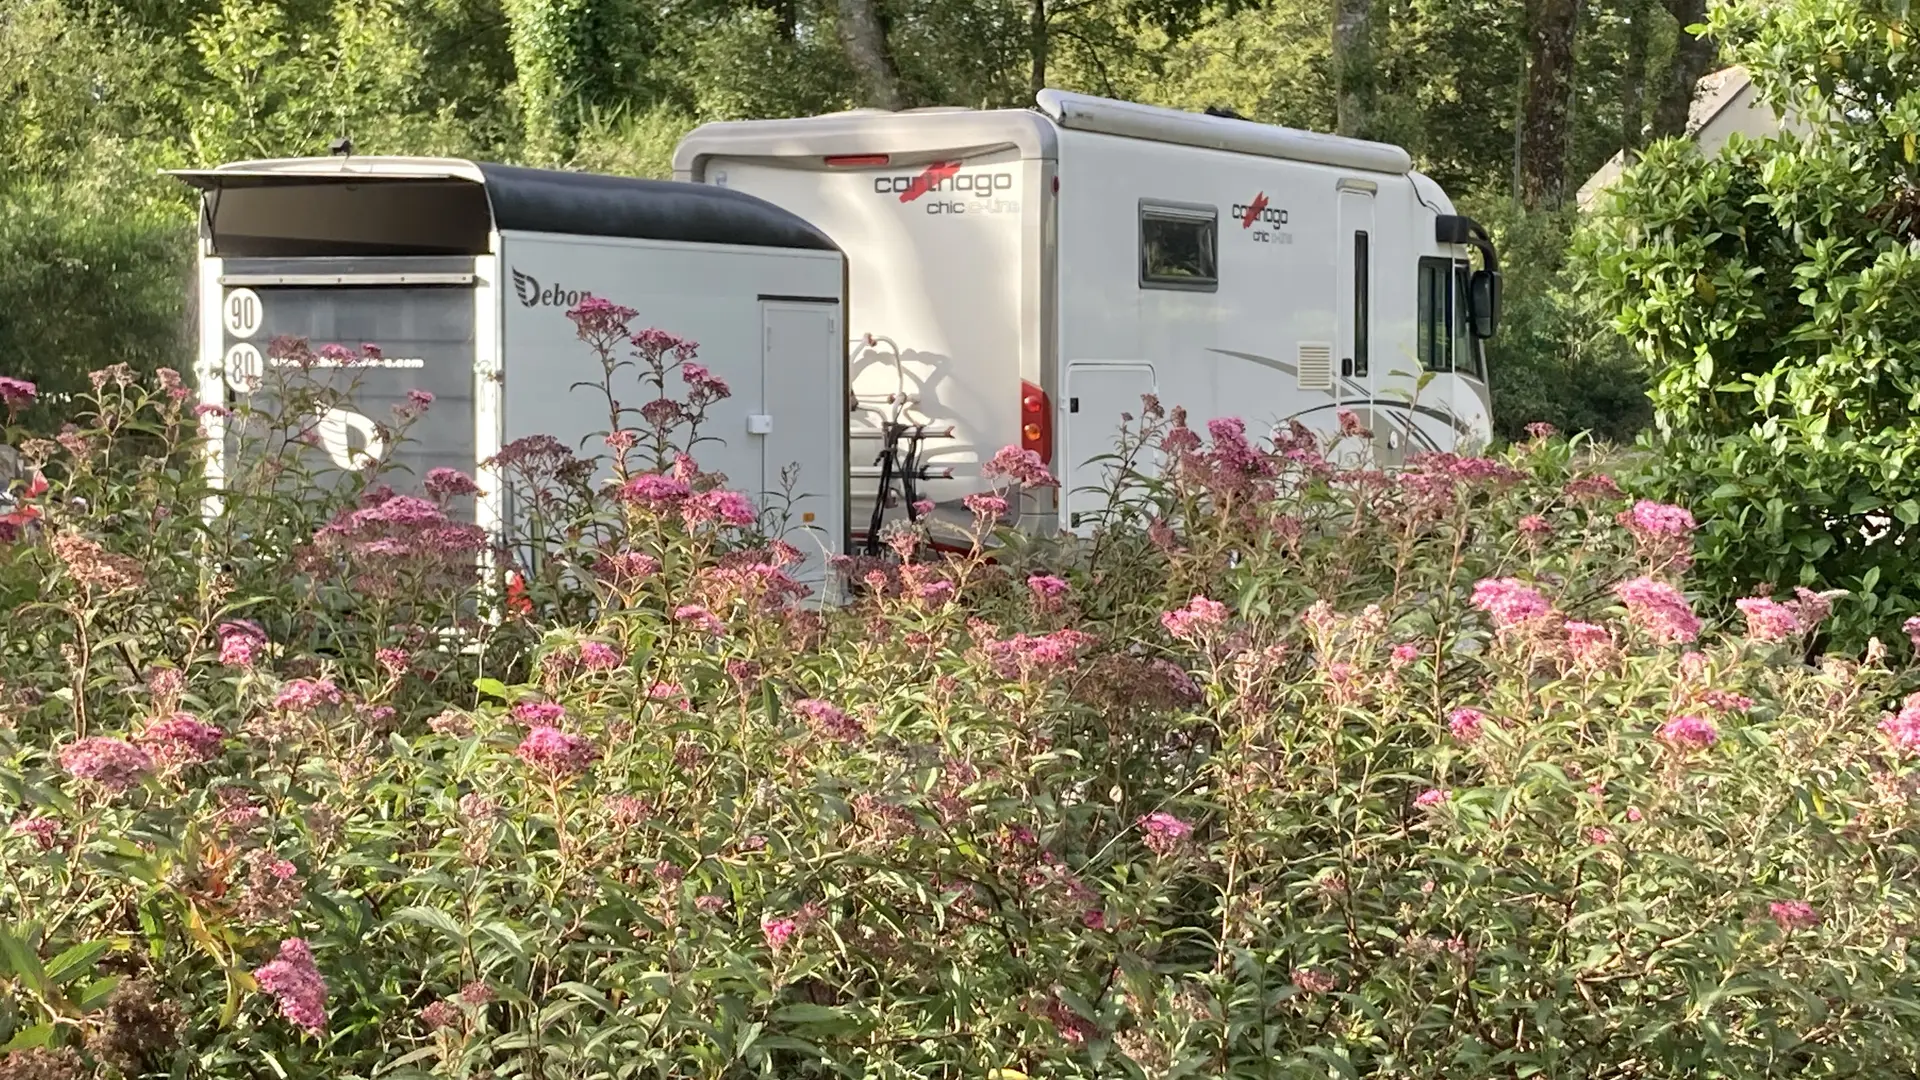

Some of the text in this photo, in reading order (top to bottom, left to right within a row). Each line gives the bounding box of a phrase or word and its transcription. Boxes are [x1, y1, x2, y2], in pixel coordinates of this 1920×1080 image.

[926, 201, 965, 214] chic
[231, 296, 255, 330] 90
[231, 350, 255, 385] 80
